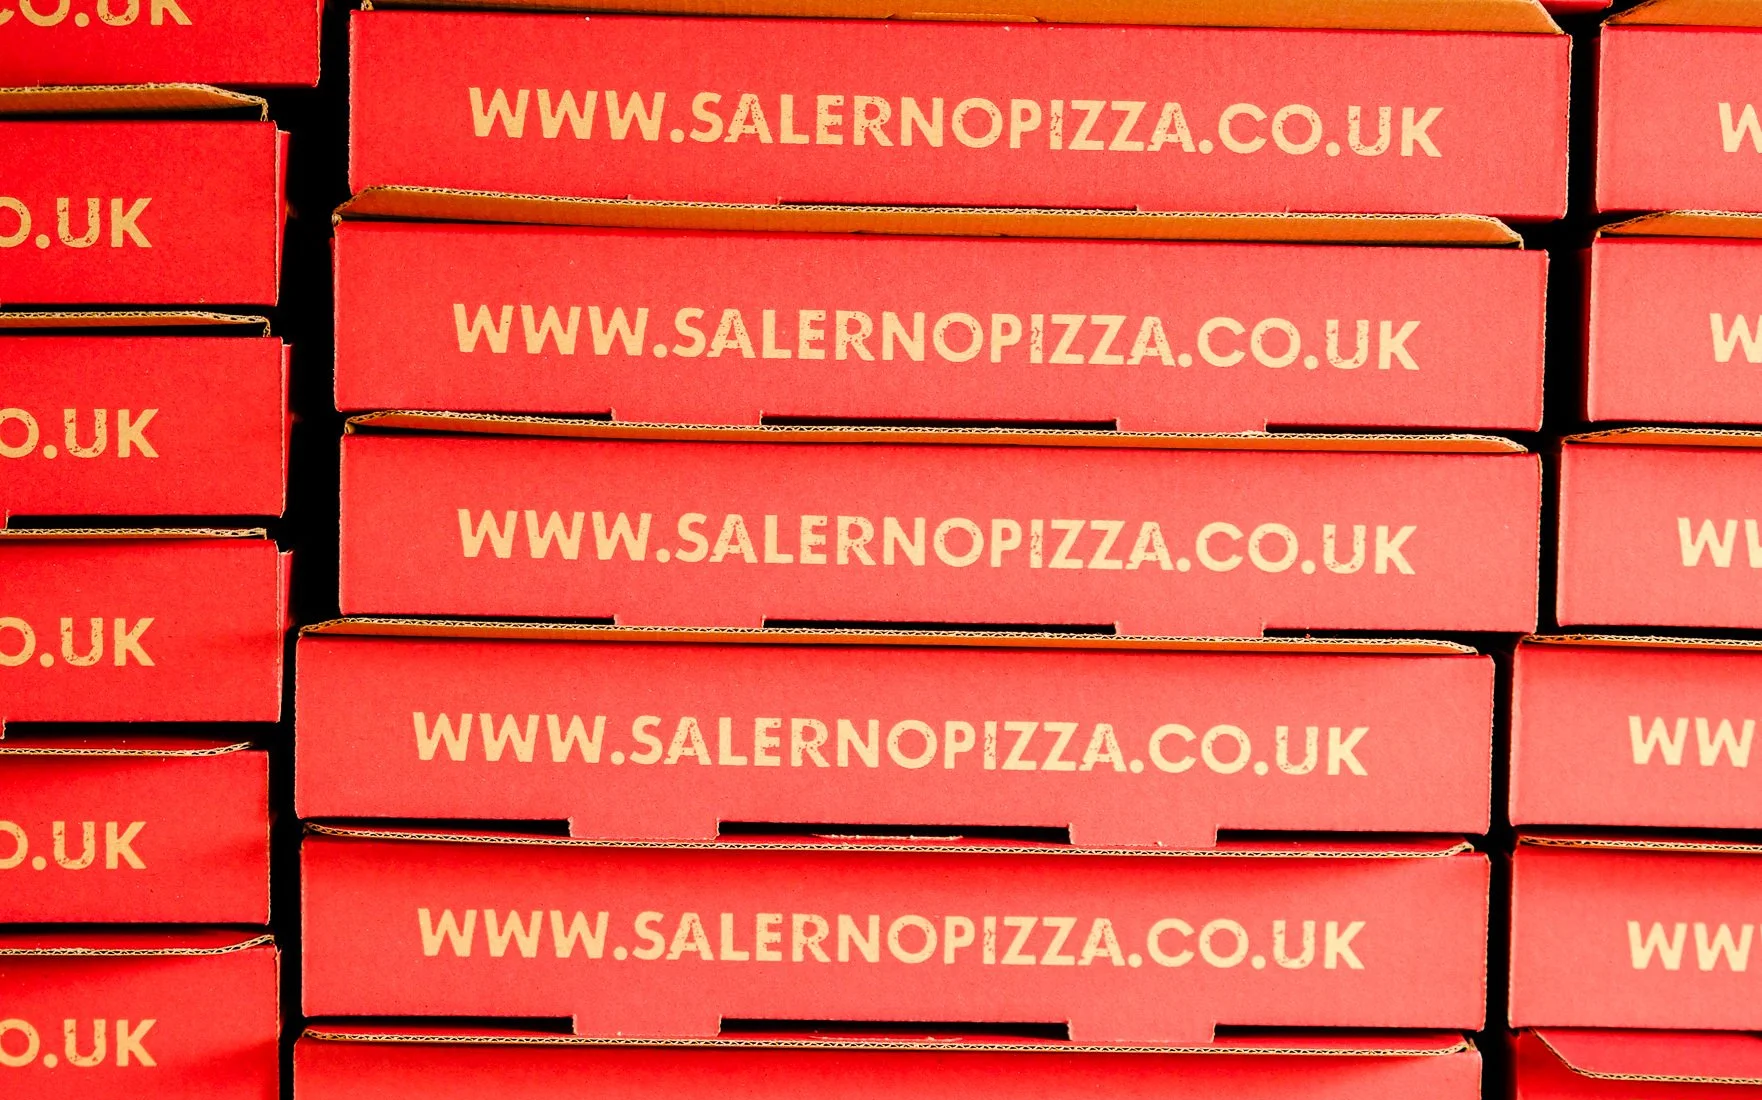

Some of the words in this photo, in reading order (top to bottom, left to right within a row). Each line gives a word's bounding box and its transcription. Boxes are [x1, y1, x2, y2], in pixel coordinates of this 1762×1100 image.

[470, 87, 1440, 156] WWW.SALERNOPIZZA.CO.UK
[454, 304, 1417, 369] WWW.SALERNOPIZZA.CO.UK
[1712, 314, 1762, 362] W
[0, 408, 158, 458] O.UK
[459, 509, 1415, 573] WWW.SALERNOPIZZA.CO.UK
[0, 617, 153, 667] O.UK
[414, 712, 1367, 775] WWW.SALERNOPIZZA.CO.UK
[418, 908, 1363, 968] WWW.SALERNOPIZZA.CO.UK
[1629, 921, 1762, 969] WW
[0, 1019, 156, 1067] O.UK
